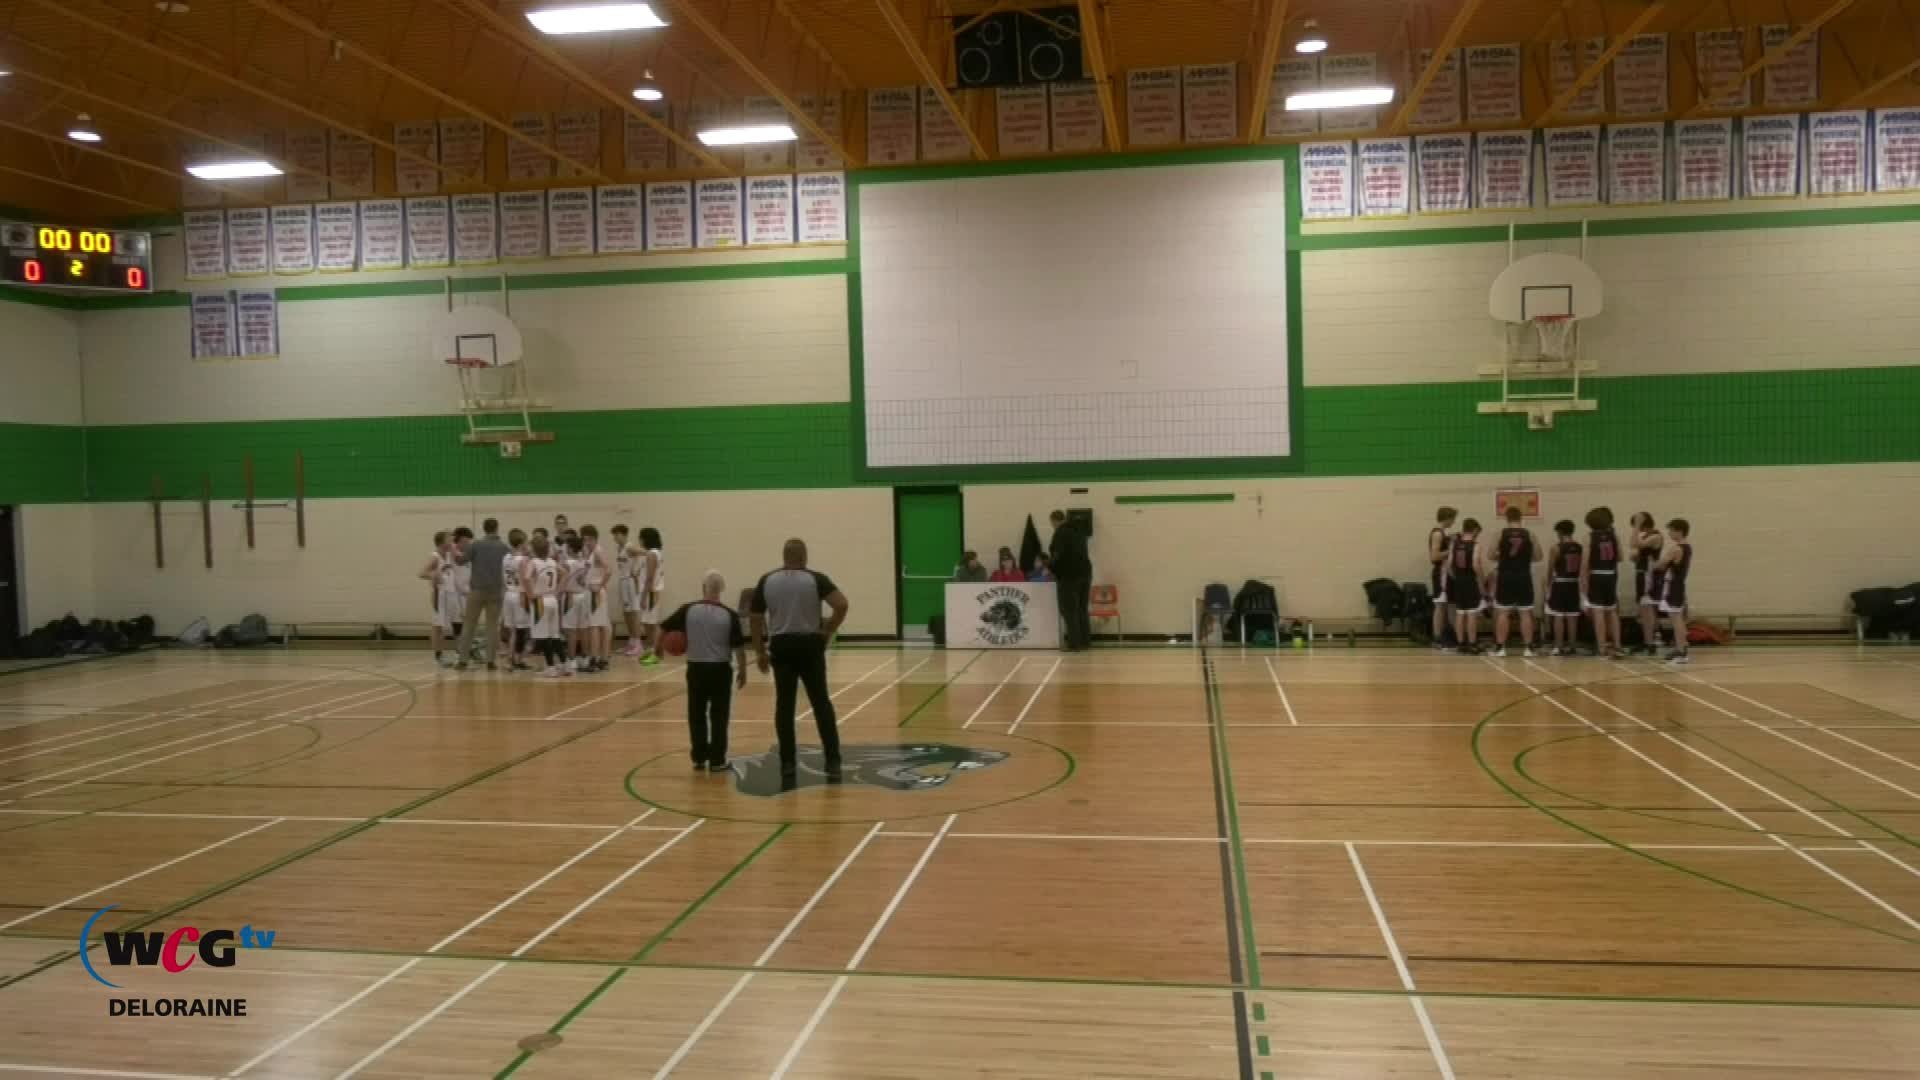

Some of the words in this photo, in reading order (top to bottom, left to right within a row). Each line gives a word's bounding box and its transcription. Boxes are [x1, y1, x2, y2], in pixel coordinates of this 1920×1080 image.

[39, 227, 71, 251] 00
[79, 231, 111, 253] 00
[24, 259, 41, 281] 0
[127, 267, 143, 288] 0
